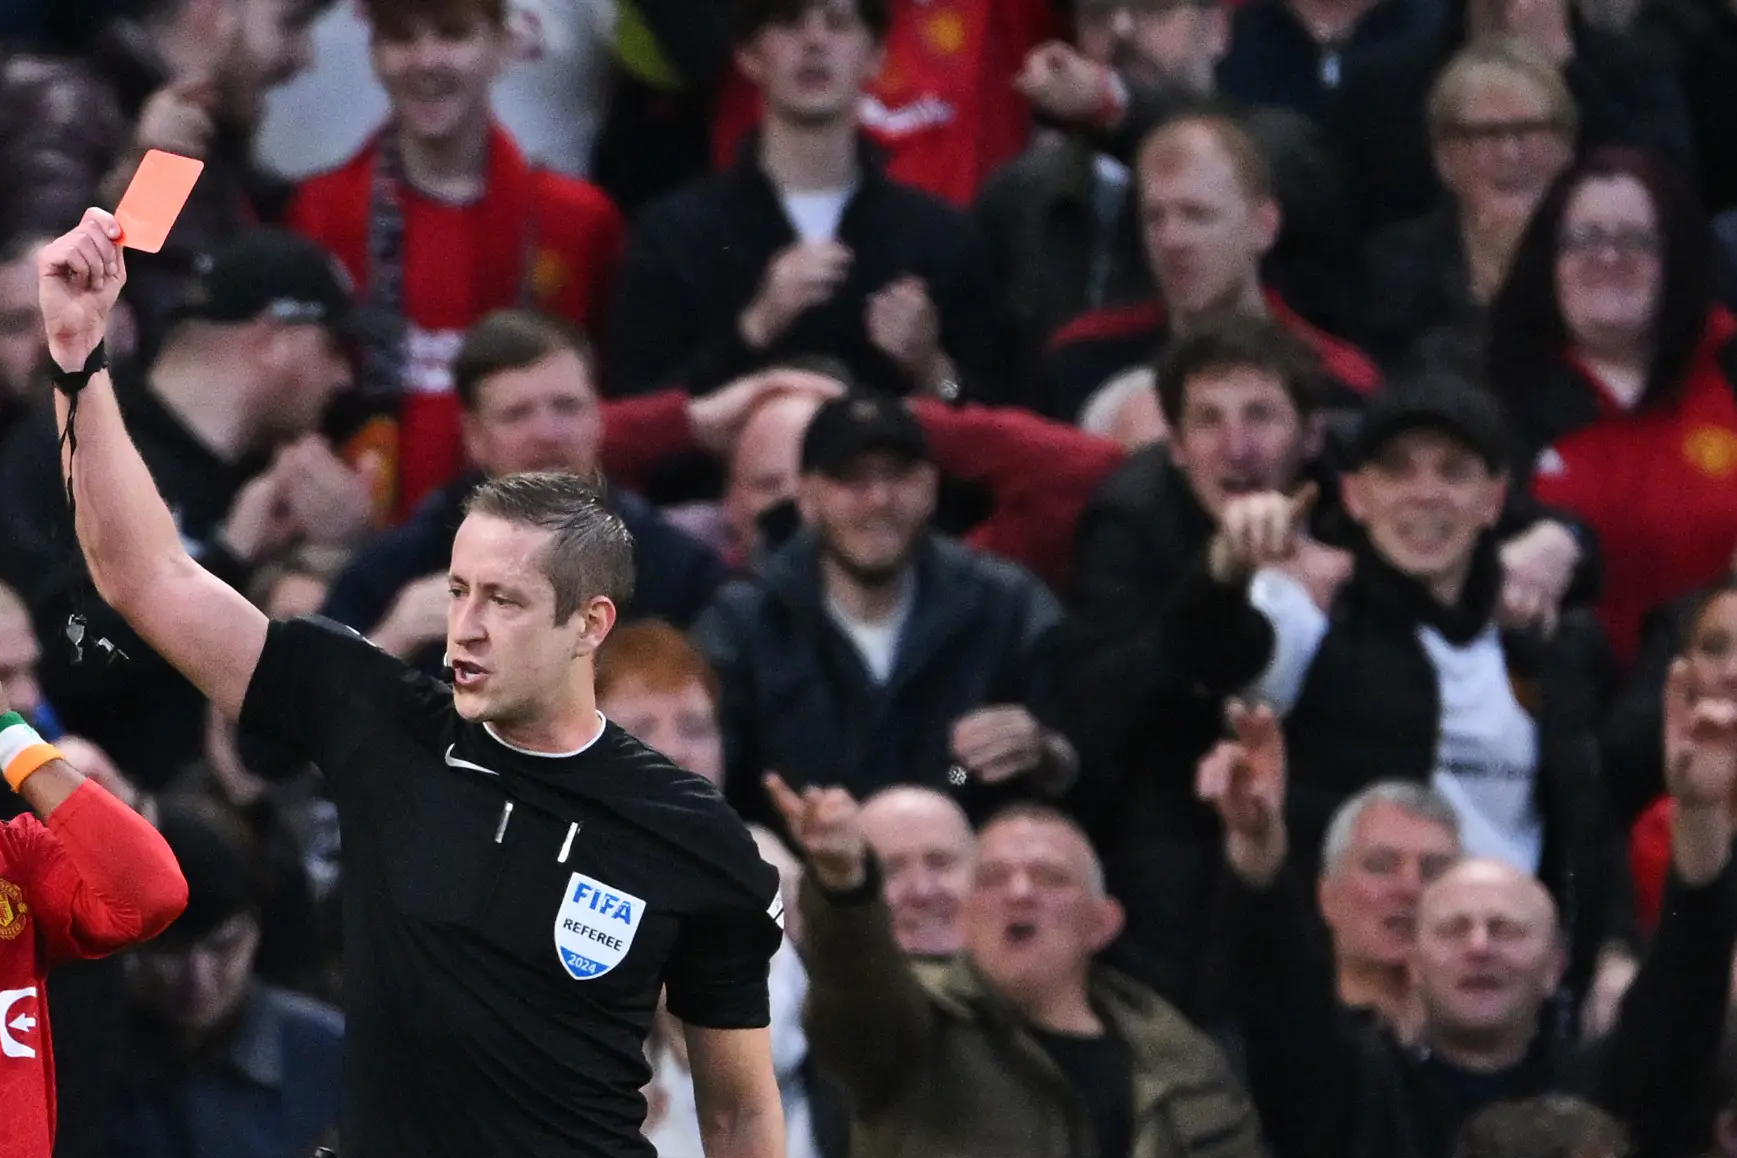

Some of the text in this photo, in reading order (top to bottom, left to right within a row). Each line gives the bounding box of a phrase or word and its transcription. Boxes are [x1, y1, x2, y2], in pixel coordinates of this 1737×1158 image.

[572, 881, 631, 925] FIFA
[563, 918, 624, 952] REFEREE
[567, 954, 597, 975] 2024
